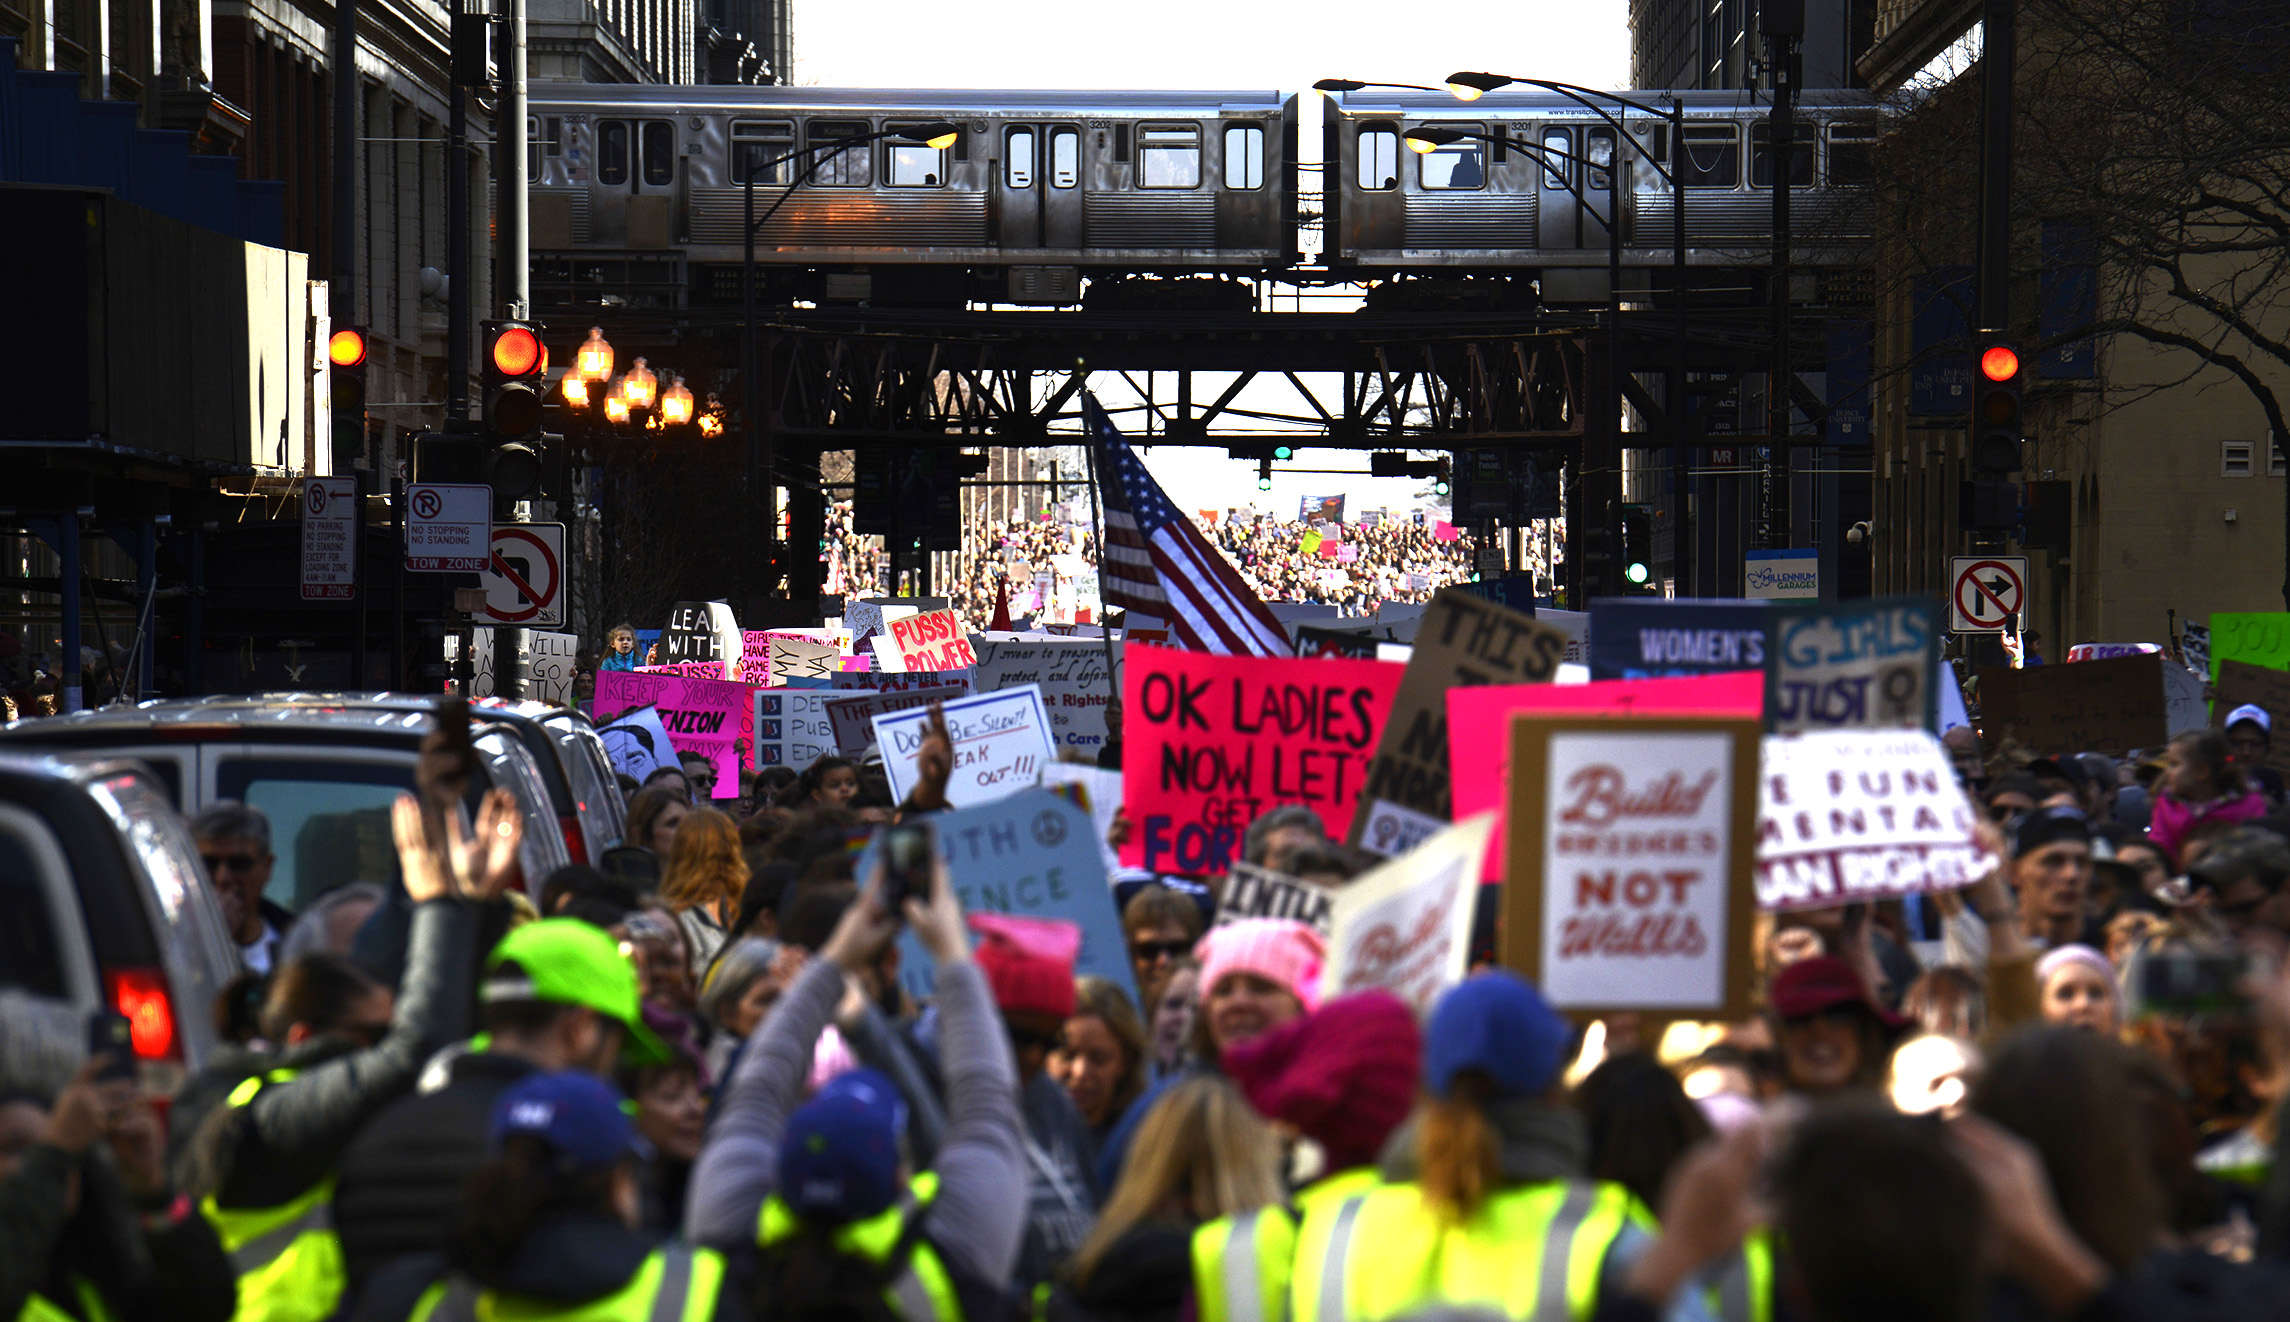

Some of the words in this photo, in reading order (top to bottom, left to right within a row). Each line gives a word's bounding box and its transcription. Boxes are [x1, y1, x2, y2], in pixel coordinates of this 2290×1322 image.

[565, 115, 586, 123] 3202
[1090, 120, 1111, 129] 3202
[1511, 122, 1531, 130] 3201
[307, 521, 315, 530] NO
[317, 521, 343, 531] PARKING
[412, 525, 424, 534] NO
[427, 526, 470, 535] STOPPING
[307, 532, 314, 540] NO
[317, 532, 346, 541] STOPPING
[411, 535, 424, 544] NO
[427, 536, 470, 545] STANDING
[306, 542, 314, 551] NO
[317, 542, 344, 551] STANDING
[1482, 551, 1501, 560] END
[306, 552, 326, 561] EXCEPT
[328, 552, 339, 561] FOR
[411, 558, 440, 569] TOW
[446, 559, 483, 570] ZONE
[306, 563, 329, 572] LOADING
[332, 563, 347, 572] ZONE
[1763, 572, 1816, 582] MILLENNIUM
[1777, 581, 1816, 590] GARAGES
[305, 585, 323, 596] TOW
[327, 585, 350, 597] ZONE
[671, 608, 724, 633] LEAD
[891, 610, 957, 653] PUSSY
[1437, 598, 1563, 681] THIS
[1785, 607, 1929, 669] GIRLS
[668, 635, 725, 660] WITH
[1000, 649, 1034, 660] swear
[1041, 648, 1053, 658] to
[1639, 627, 1766, 665] WOMEN'S
[903, 638, 976, 673] POWER
[533, 658, 561, 680] GO
[857, 671, 874, 683] WE
[878, 671, 898, 683] ARE
[904, 671, 938, 683] NEVER
[1048, 659, 1079, 682] and
[604, 673, 669, 704] KEEP
[681, 679, 735, 707] YOUR
[1775, 673, 1872, 724] JUST
[1063, 694, 1107, 708] Rights
[1141, 671, 1214, 732] OK
[1232, 677, 1374, 749] LADIES
[791, 719, 832, 737] PUB
[949, 719, 977, 742] BE
[1066, 732, 1101, 745] Care
[954, 744, 989, 769] EAK
[1161, 742, 1253, 793] NOW
[1826, 767, 1940, 800] FUN
[1559, 760, 1721, 830] Build
[1574, 868, 1704, 910] NOT
[1557, 912, 1710, 964] Walls
